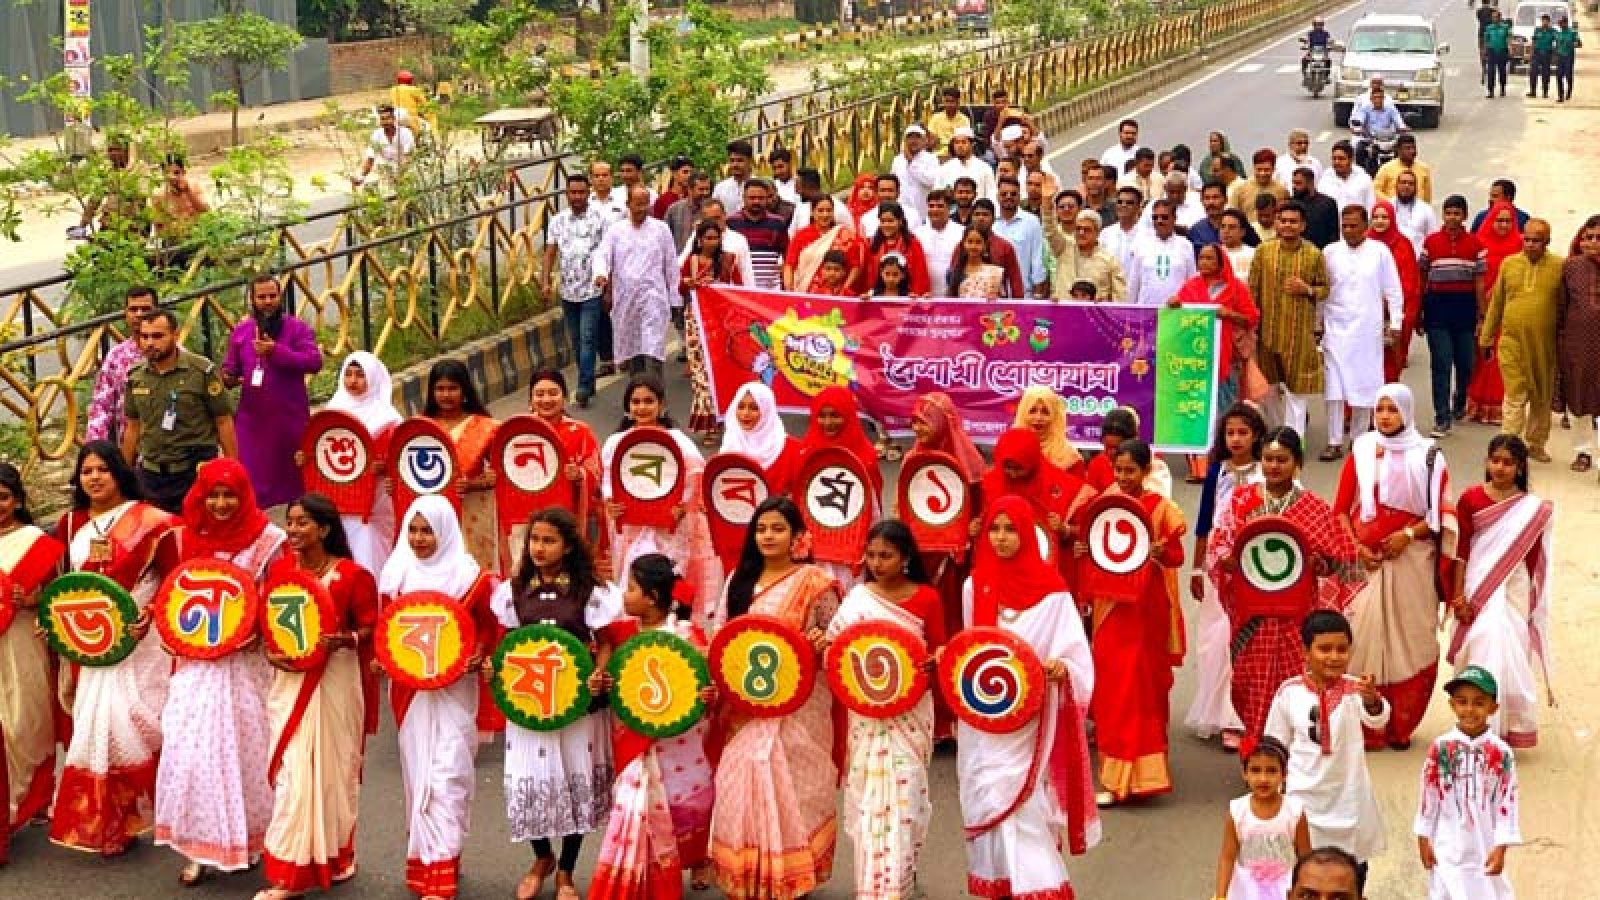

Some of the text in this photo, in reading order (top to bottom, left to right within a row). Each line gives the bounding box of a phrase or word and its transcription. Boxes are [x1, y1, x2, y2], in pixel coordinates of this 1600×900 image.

[879, 342, 1121, 396] বৈশাখী শোভাযাত্রা
[324, 437, 358, 477] শু
[407, 445, 446, 489] ভ
[511, 441, 549, 477] ন
[628, 453, 667, 489] ব
[720, 477, 758, 508] ব
[815, 471, 856, 519] র্ষ
[925, 469, 951, 515] ১
[1102, 518, 1137, 564] ৩
[1250, 537, 1297, 583] ৩
[51, 597, 114, 656] ভ
[175, 570, 243, 646] ন
[267, 593, 308, 653] ব
[397, 612, 449, 677] ব
[505, 642, 565, 719] র্ষ
[638, 656, 671, 713] ১
[742, 641, 781, 700] ৪
[848, 642, 903, 705] ৩
